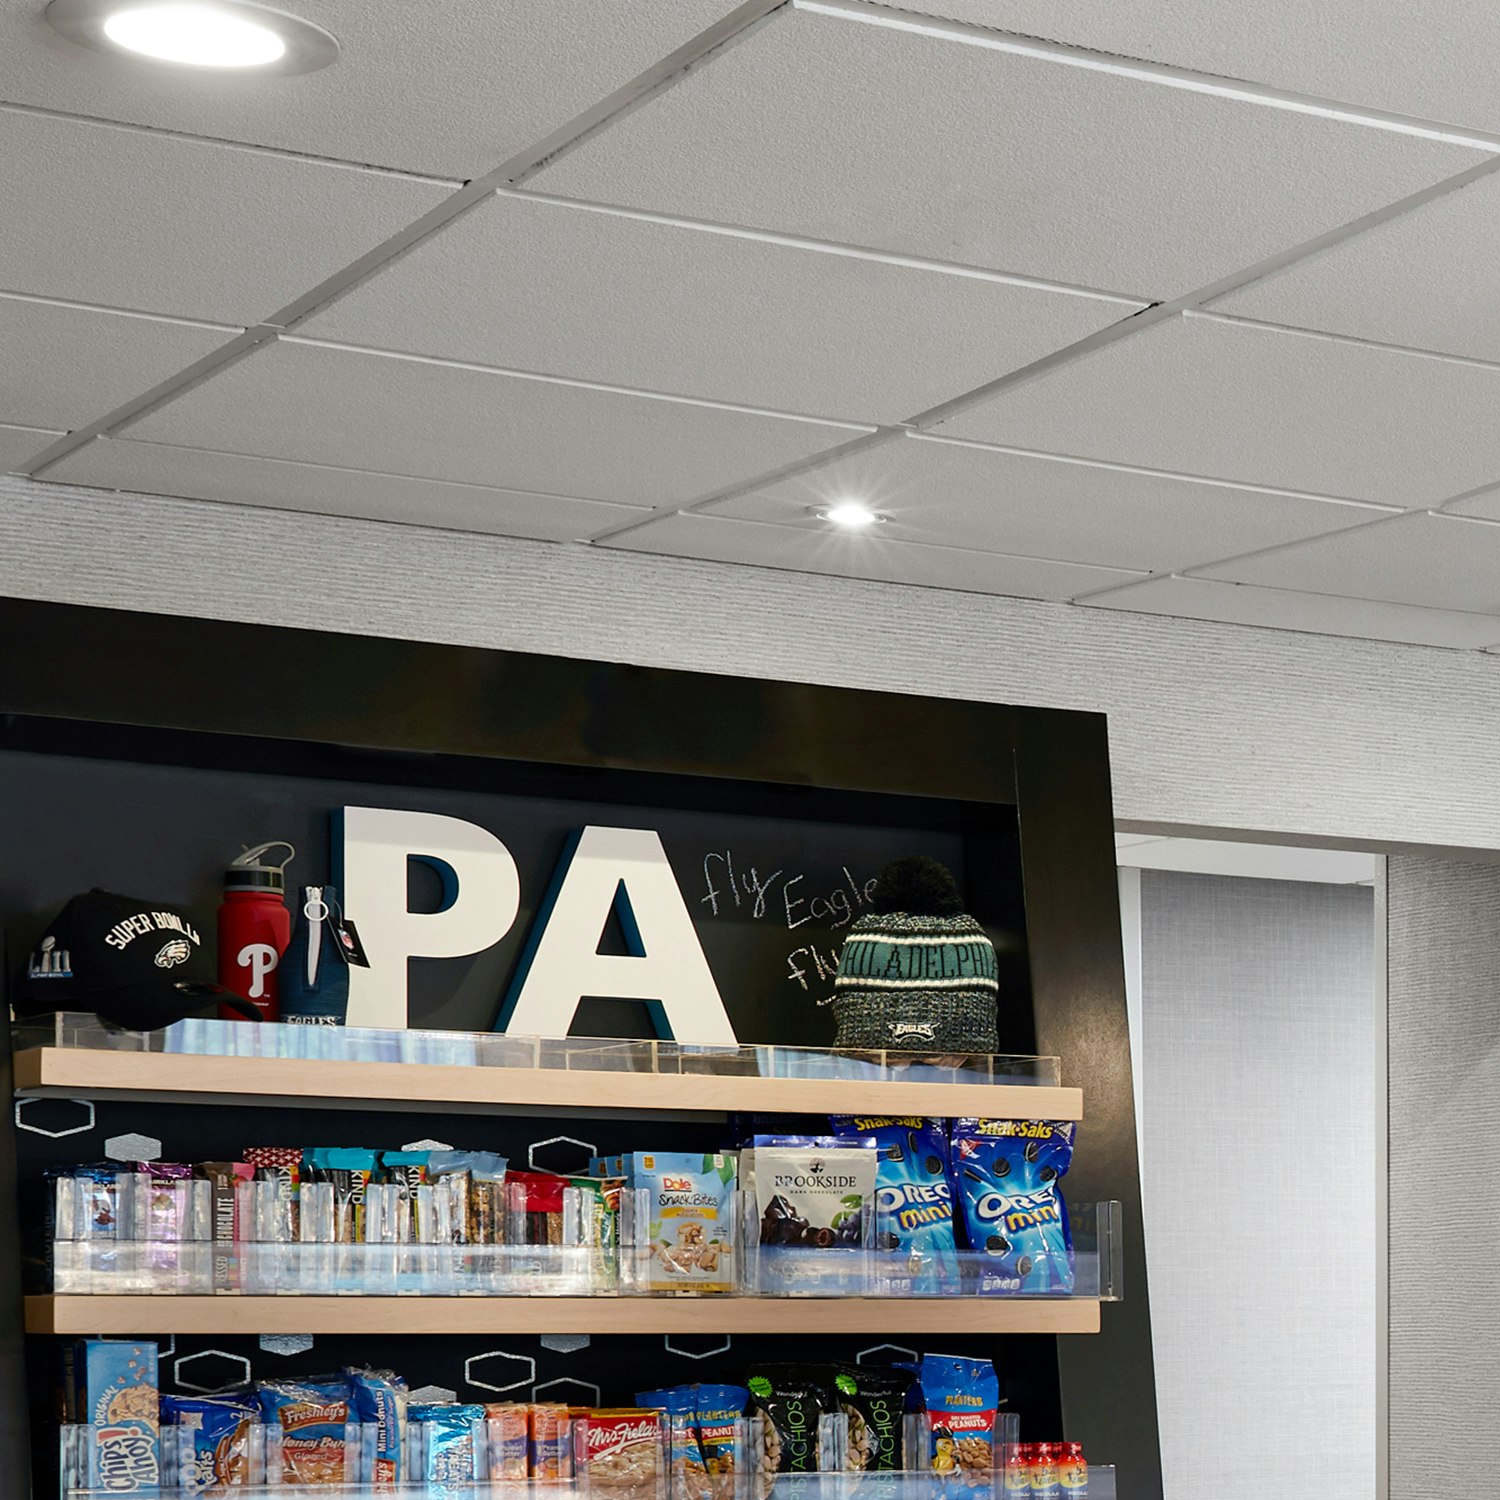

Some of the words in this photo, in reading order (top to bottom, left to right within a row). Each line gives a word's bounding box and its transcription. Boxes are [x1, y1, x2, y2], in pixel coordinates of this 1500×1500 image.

[700, 850, 783, 919] fly
[105, 912, 156, 950] SUPER
[151, 911, 188, 936] BOWL
[338, 805, 740, 1047] PA
[894, 1022, 932, 1036] EAGLES
[278, 1166, 292, 1202] KIND
[351, 1170, 363, 1205] KIND
[408, 1165, 420, 1200] KIND
[662, 1177, 691, 1190] Dole
[774, 1175, 857, 1188] BROOKSIDE
[658, 1193, 690, 1207] Snack
[900, 1202, 952, 1230] mini
[978, 1186, 1057, 1218] ORE
[216, 1198, 234, 1240] CHOCOLATE
[1005, 1205, 1058, 1231] min
[95, 1385, 120, 1427] ORIGINAL
[376, 1389, 387, 1428] Donuts
[860, 1389, 892, 1397] Wonderful
[945, 1395, 983, 1406] PLANTERS
[284, 1404, 346, 1424] Freshley's
[948, 1418, 987, 1429] PEANUTS
[377, 1429, 387, 1452] Mini
[701, 1425, 742, 1438] PEANUTS
[870, 1400, 895, 1500] PISTACHIOS
[101, 1440, 138, 1493] Chips
[447, 1446, 460, 1492] TREATS
